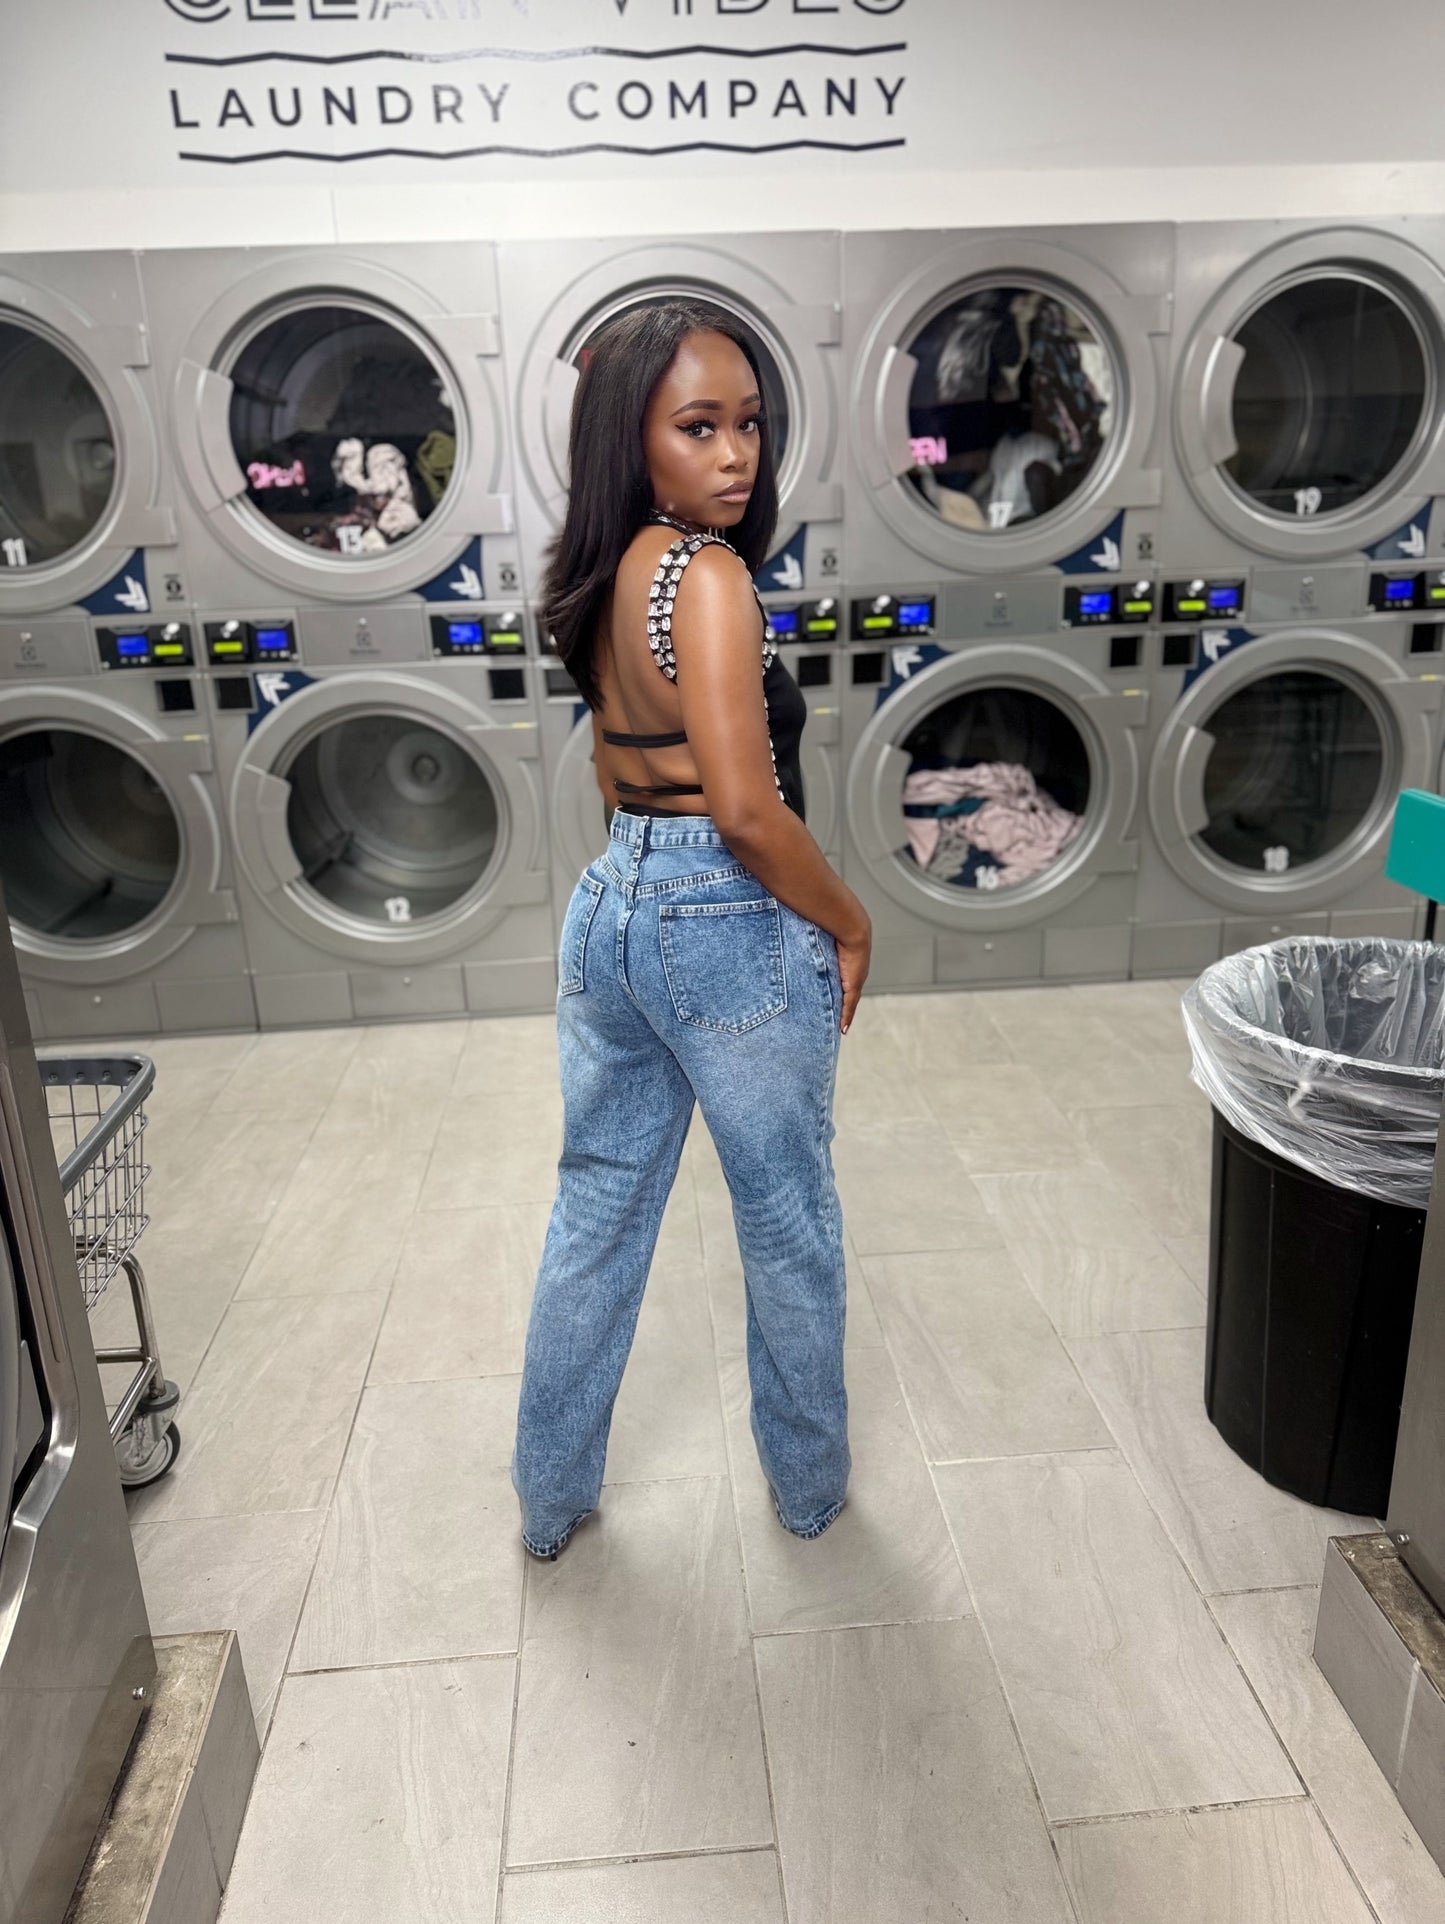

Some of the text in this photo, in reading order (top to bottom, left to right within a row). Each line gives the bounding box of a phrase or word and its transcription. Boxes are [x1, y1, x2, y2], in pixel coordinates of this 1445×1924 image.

[169, 76, 906, 128] LAUNDRY COMPANY
[987, 501, 1013, 528] 17
[1293, 486, 1322, 516] 19
[2, 538, 28, 567] 11
[336, 525, 362, 554] 13
[975, 865, 999, 890] 16
[384, 896, 412, 922] 12
